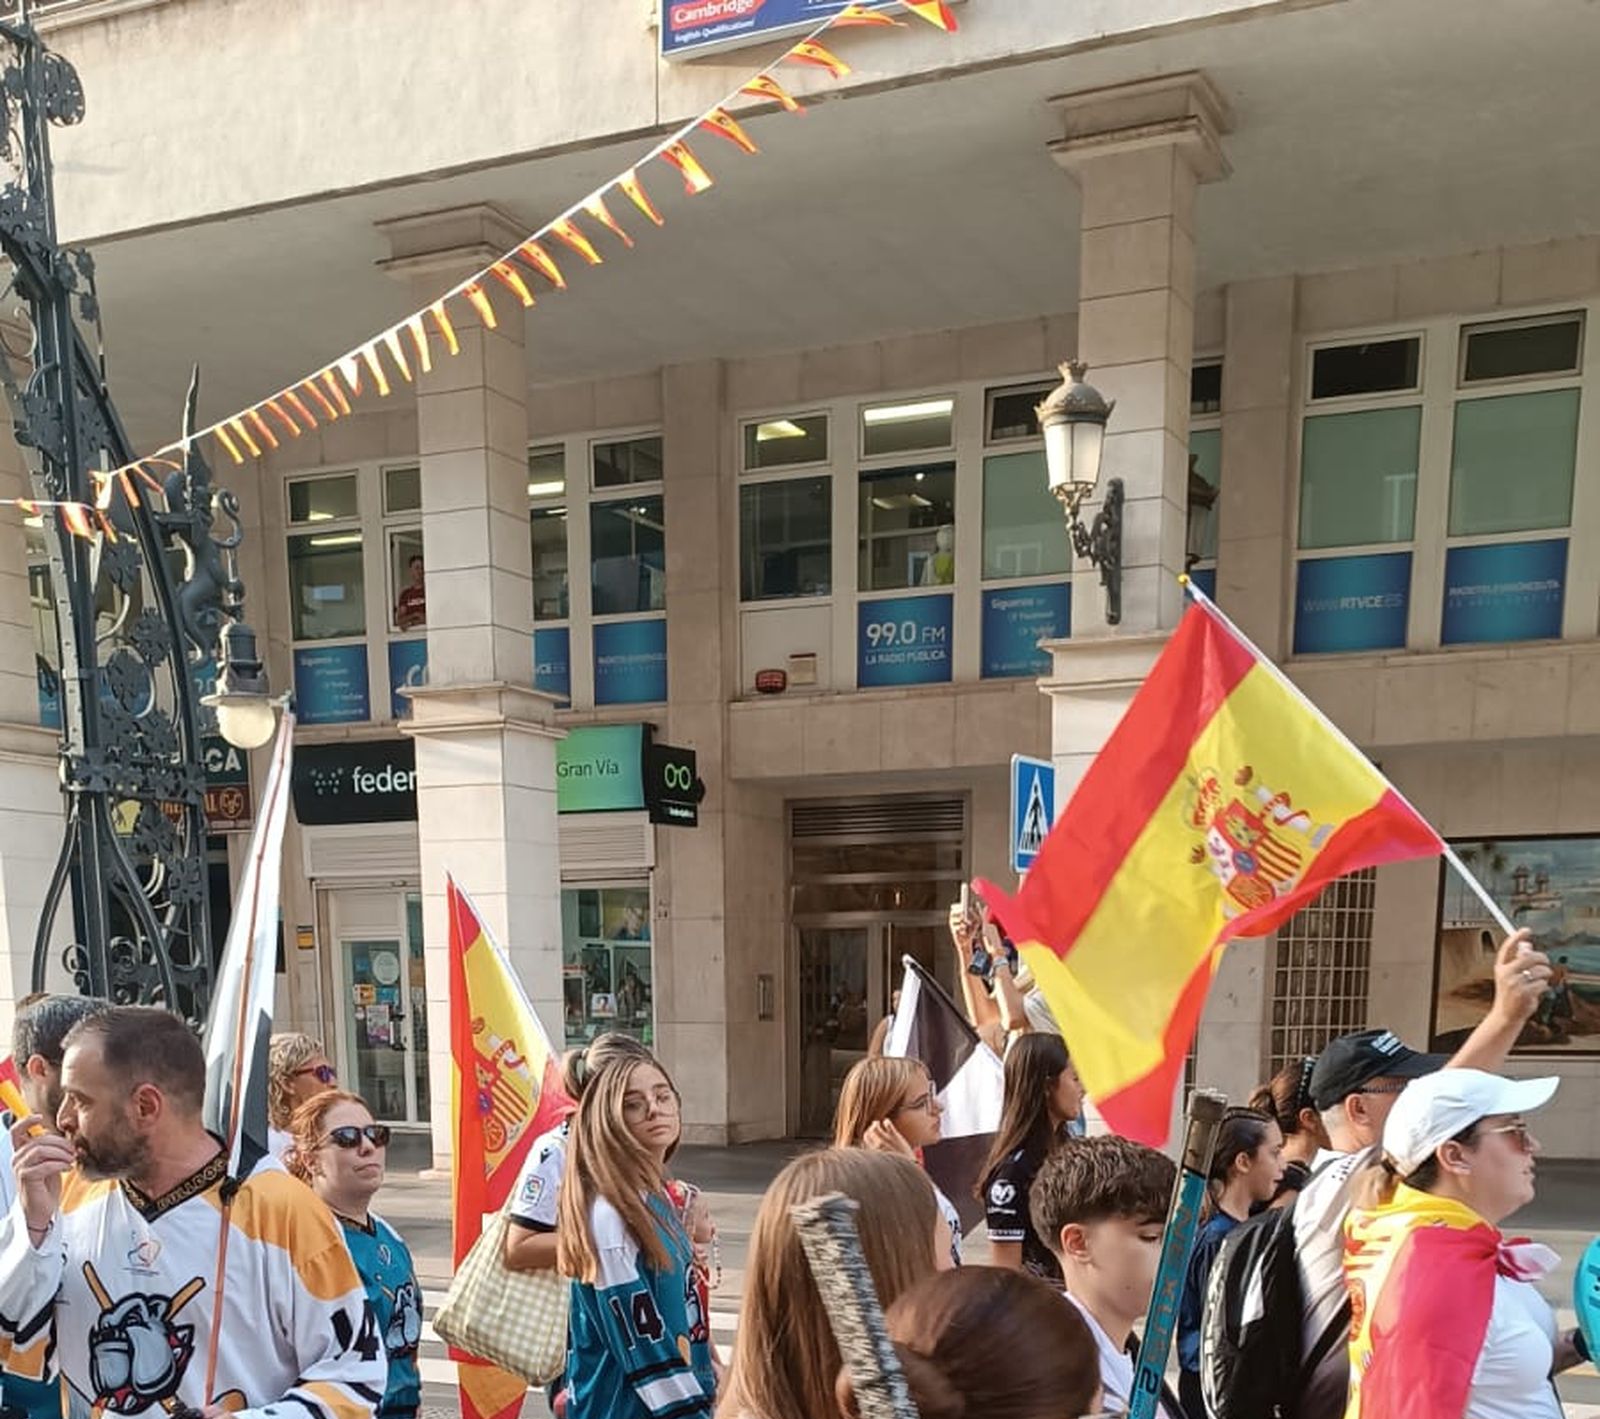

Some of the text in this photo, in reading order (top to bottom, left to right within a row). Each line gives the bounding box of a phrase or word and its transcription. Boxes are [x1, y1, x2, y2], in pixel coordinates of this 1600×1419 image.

[866, 621, 946, 647] 99.0 FM
[352, 764, 416, 794] feder
[556, 761, 592, 778] Gran
[330, 1299, 380, 1361] 14
[608, 1289, 666, 1347] 14
